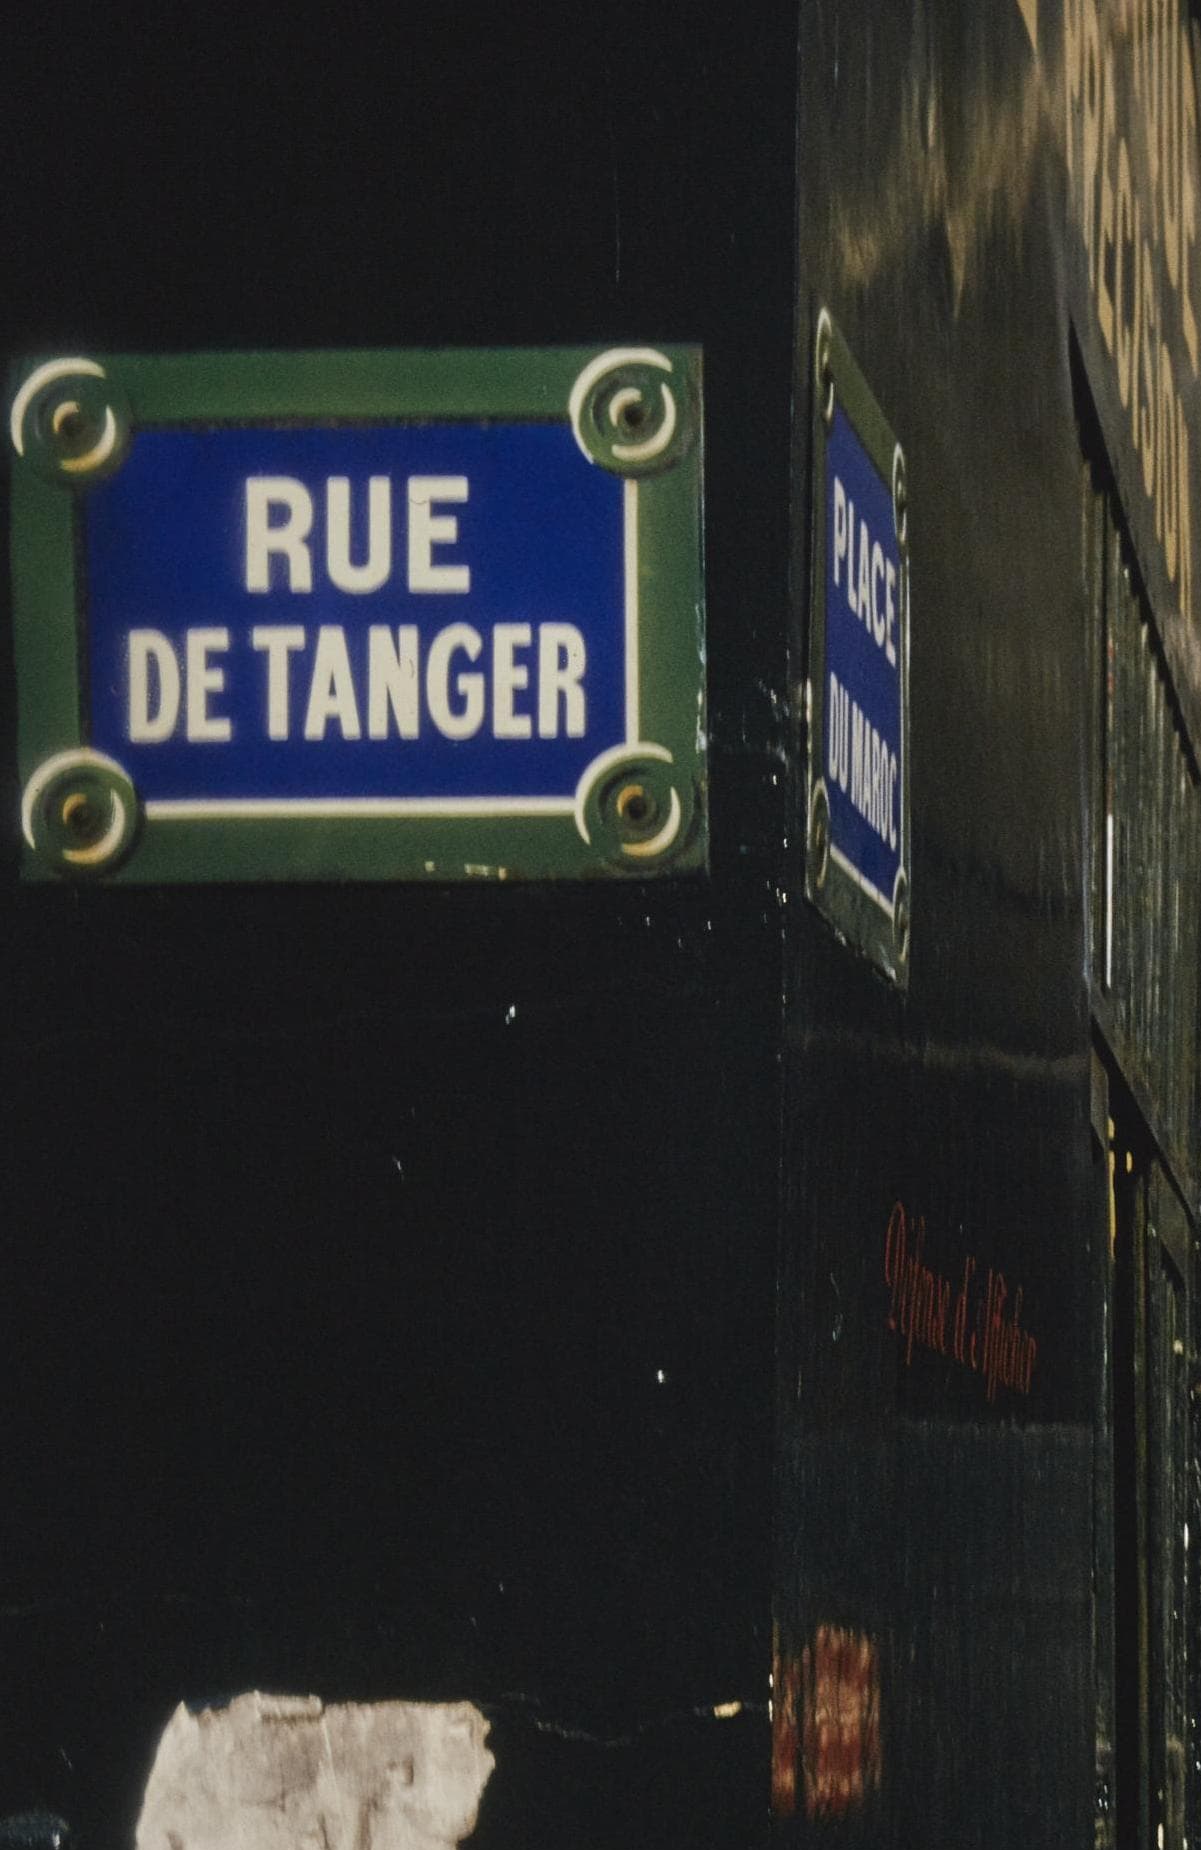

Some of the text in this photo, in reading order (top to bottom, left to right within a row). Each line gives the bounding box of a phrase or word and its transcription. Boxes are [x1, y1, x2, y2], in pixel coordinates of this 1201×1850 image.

[245, 475, 471, 594] RUE
[833, 476, 897, 667] PLACE
[128, 622, 587, 743] DE TANGER
[828, 672, 898, 852] DU MAROC
